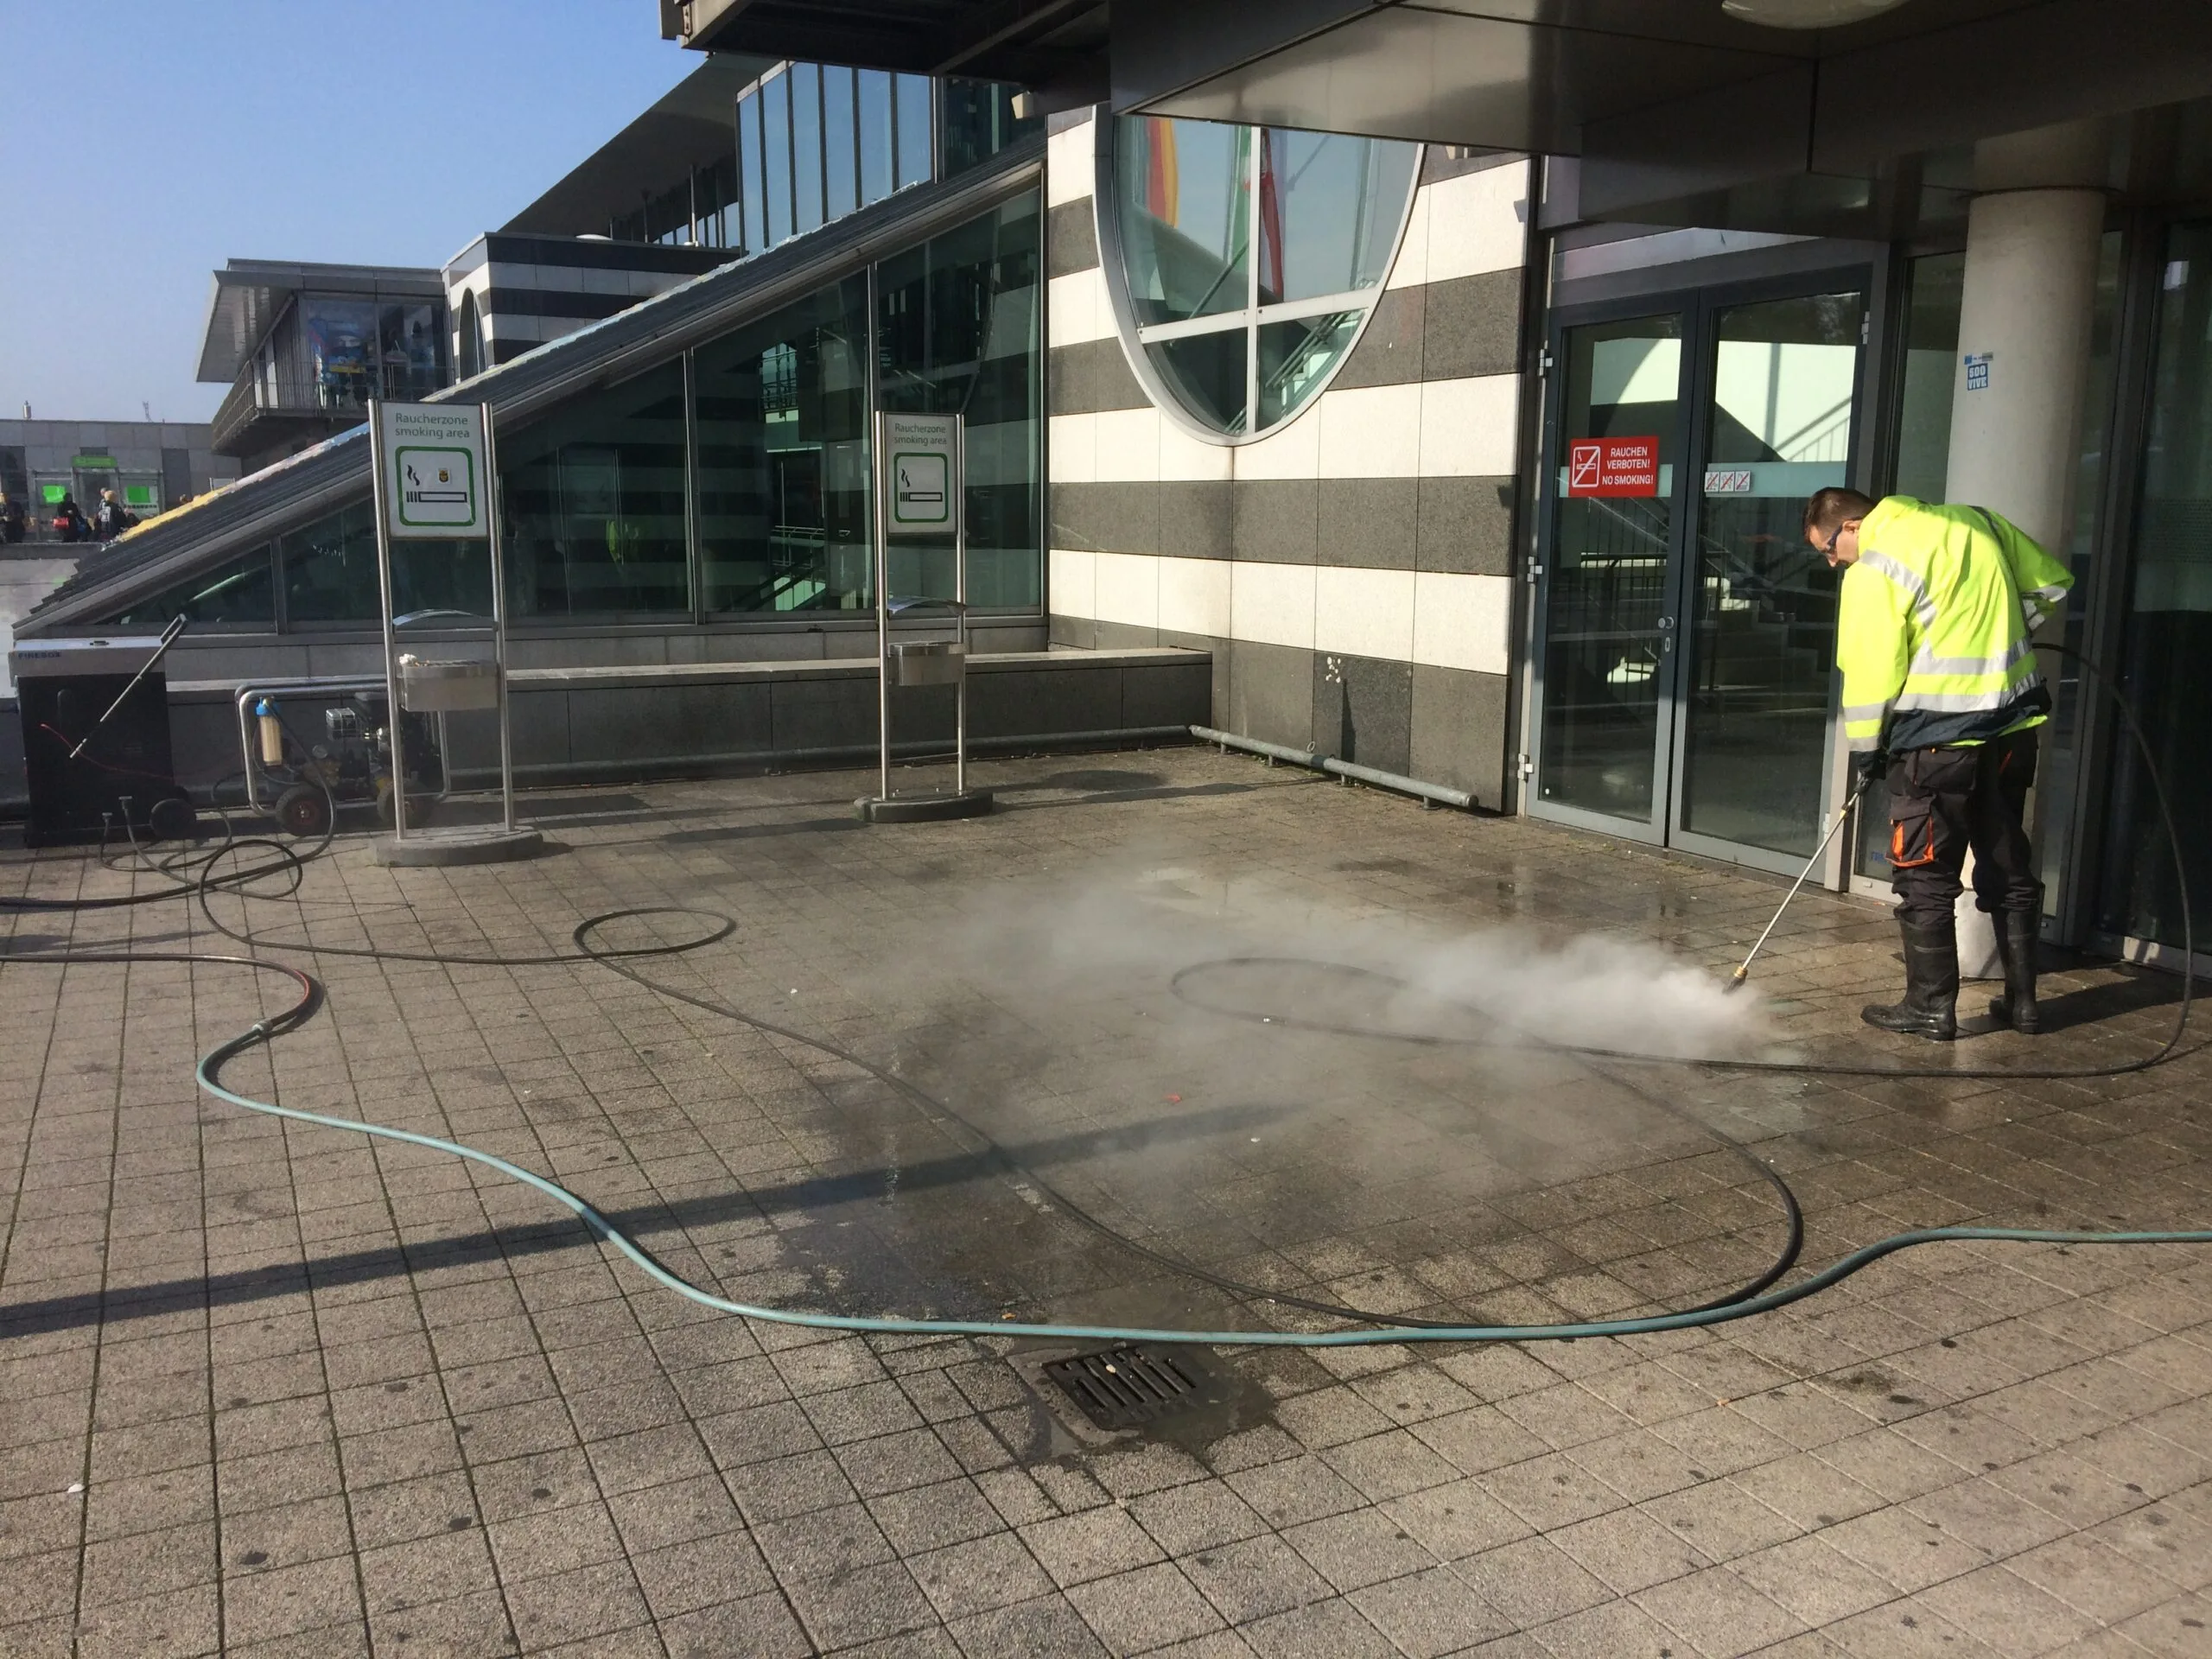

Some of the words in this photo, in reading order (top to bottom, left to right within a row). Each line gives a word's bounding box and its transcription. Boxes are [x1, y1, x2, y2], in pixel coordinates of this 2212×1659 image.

[396, 412, 468, 425] Raucherzone
[395, 427, 443, 440] smoking
[894, 423, 946, 434] Raucherzone
[894, 435, 928, 447] smoking
[1611, 447, 1648, 457] RAUCHEN
[1606, 459, 1650, 470] VERBOTEN!
[1602, 475, 1613, 485] NO
[1614, 474, 1654, 486] SMOKING!
